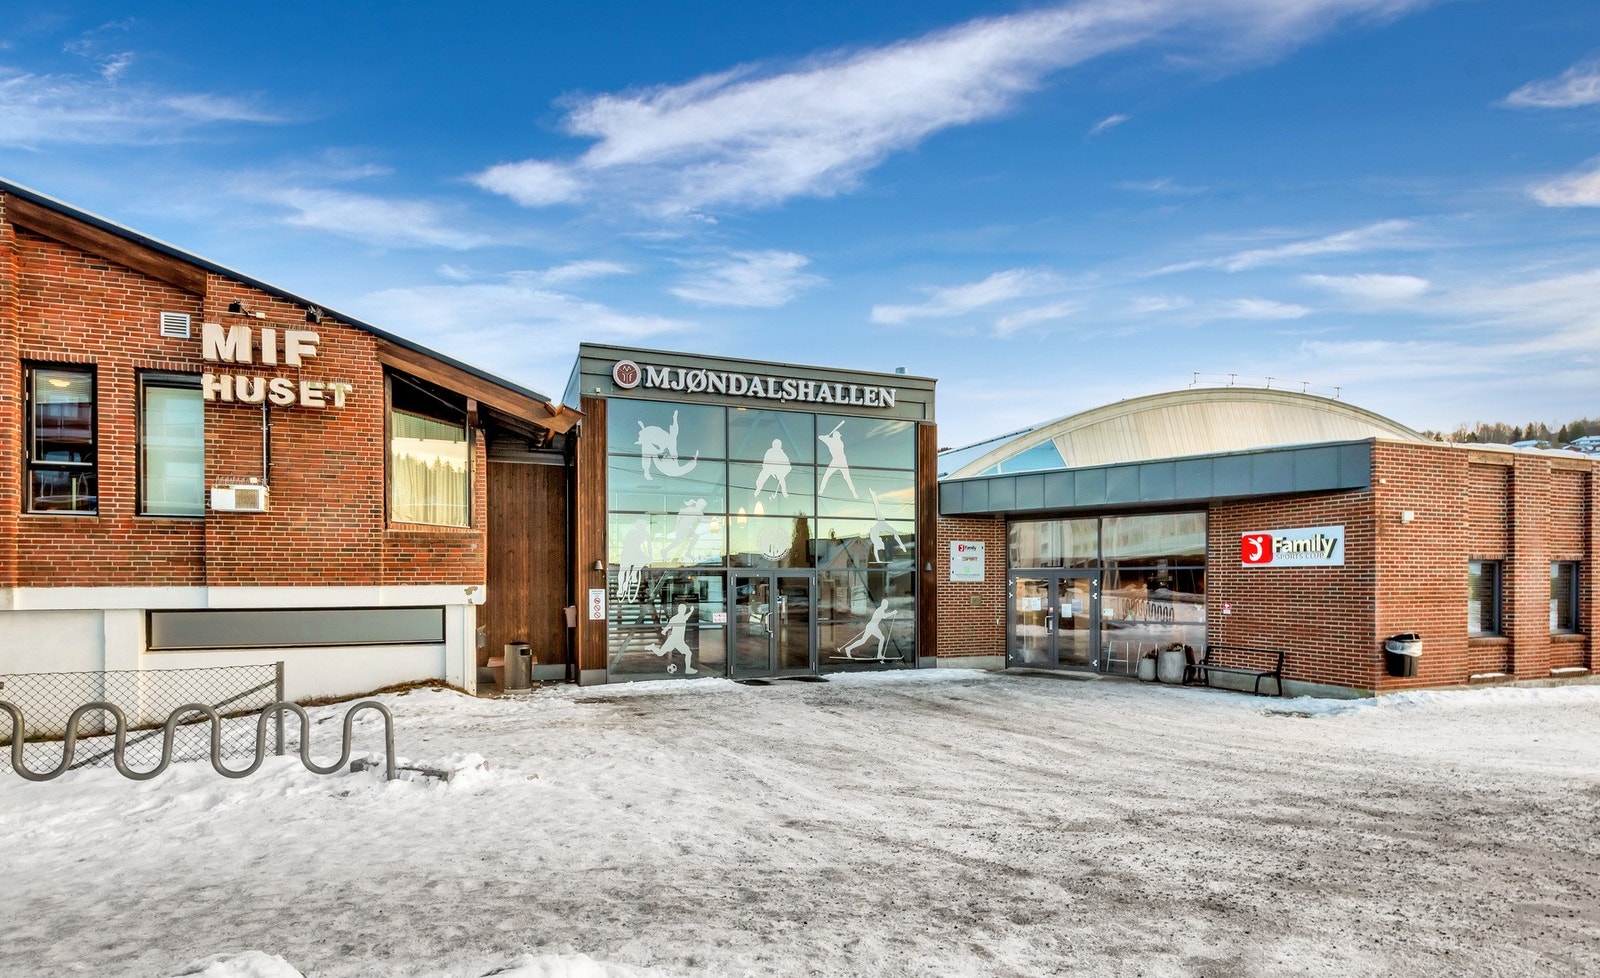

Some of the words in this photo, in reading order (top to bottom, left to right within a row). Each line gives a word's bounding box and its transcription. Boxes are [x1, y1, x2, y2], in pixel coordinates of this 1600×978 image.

[202, 323, 320, 367] MIF
[201, 373, 352, 408] HUSET
[645, 365, 896, 408] MJØNDALSHALLEN
[1272, 533, 1338, 559] Family
[1275, 552, 1303, 560] SPORTS
